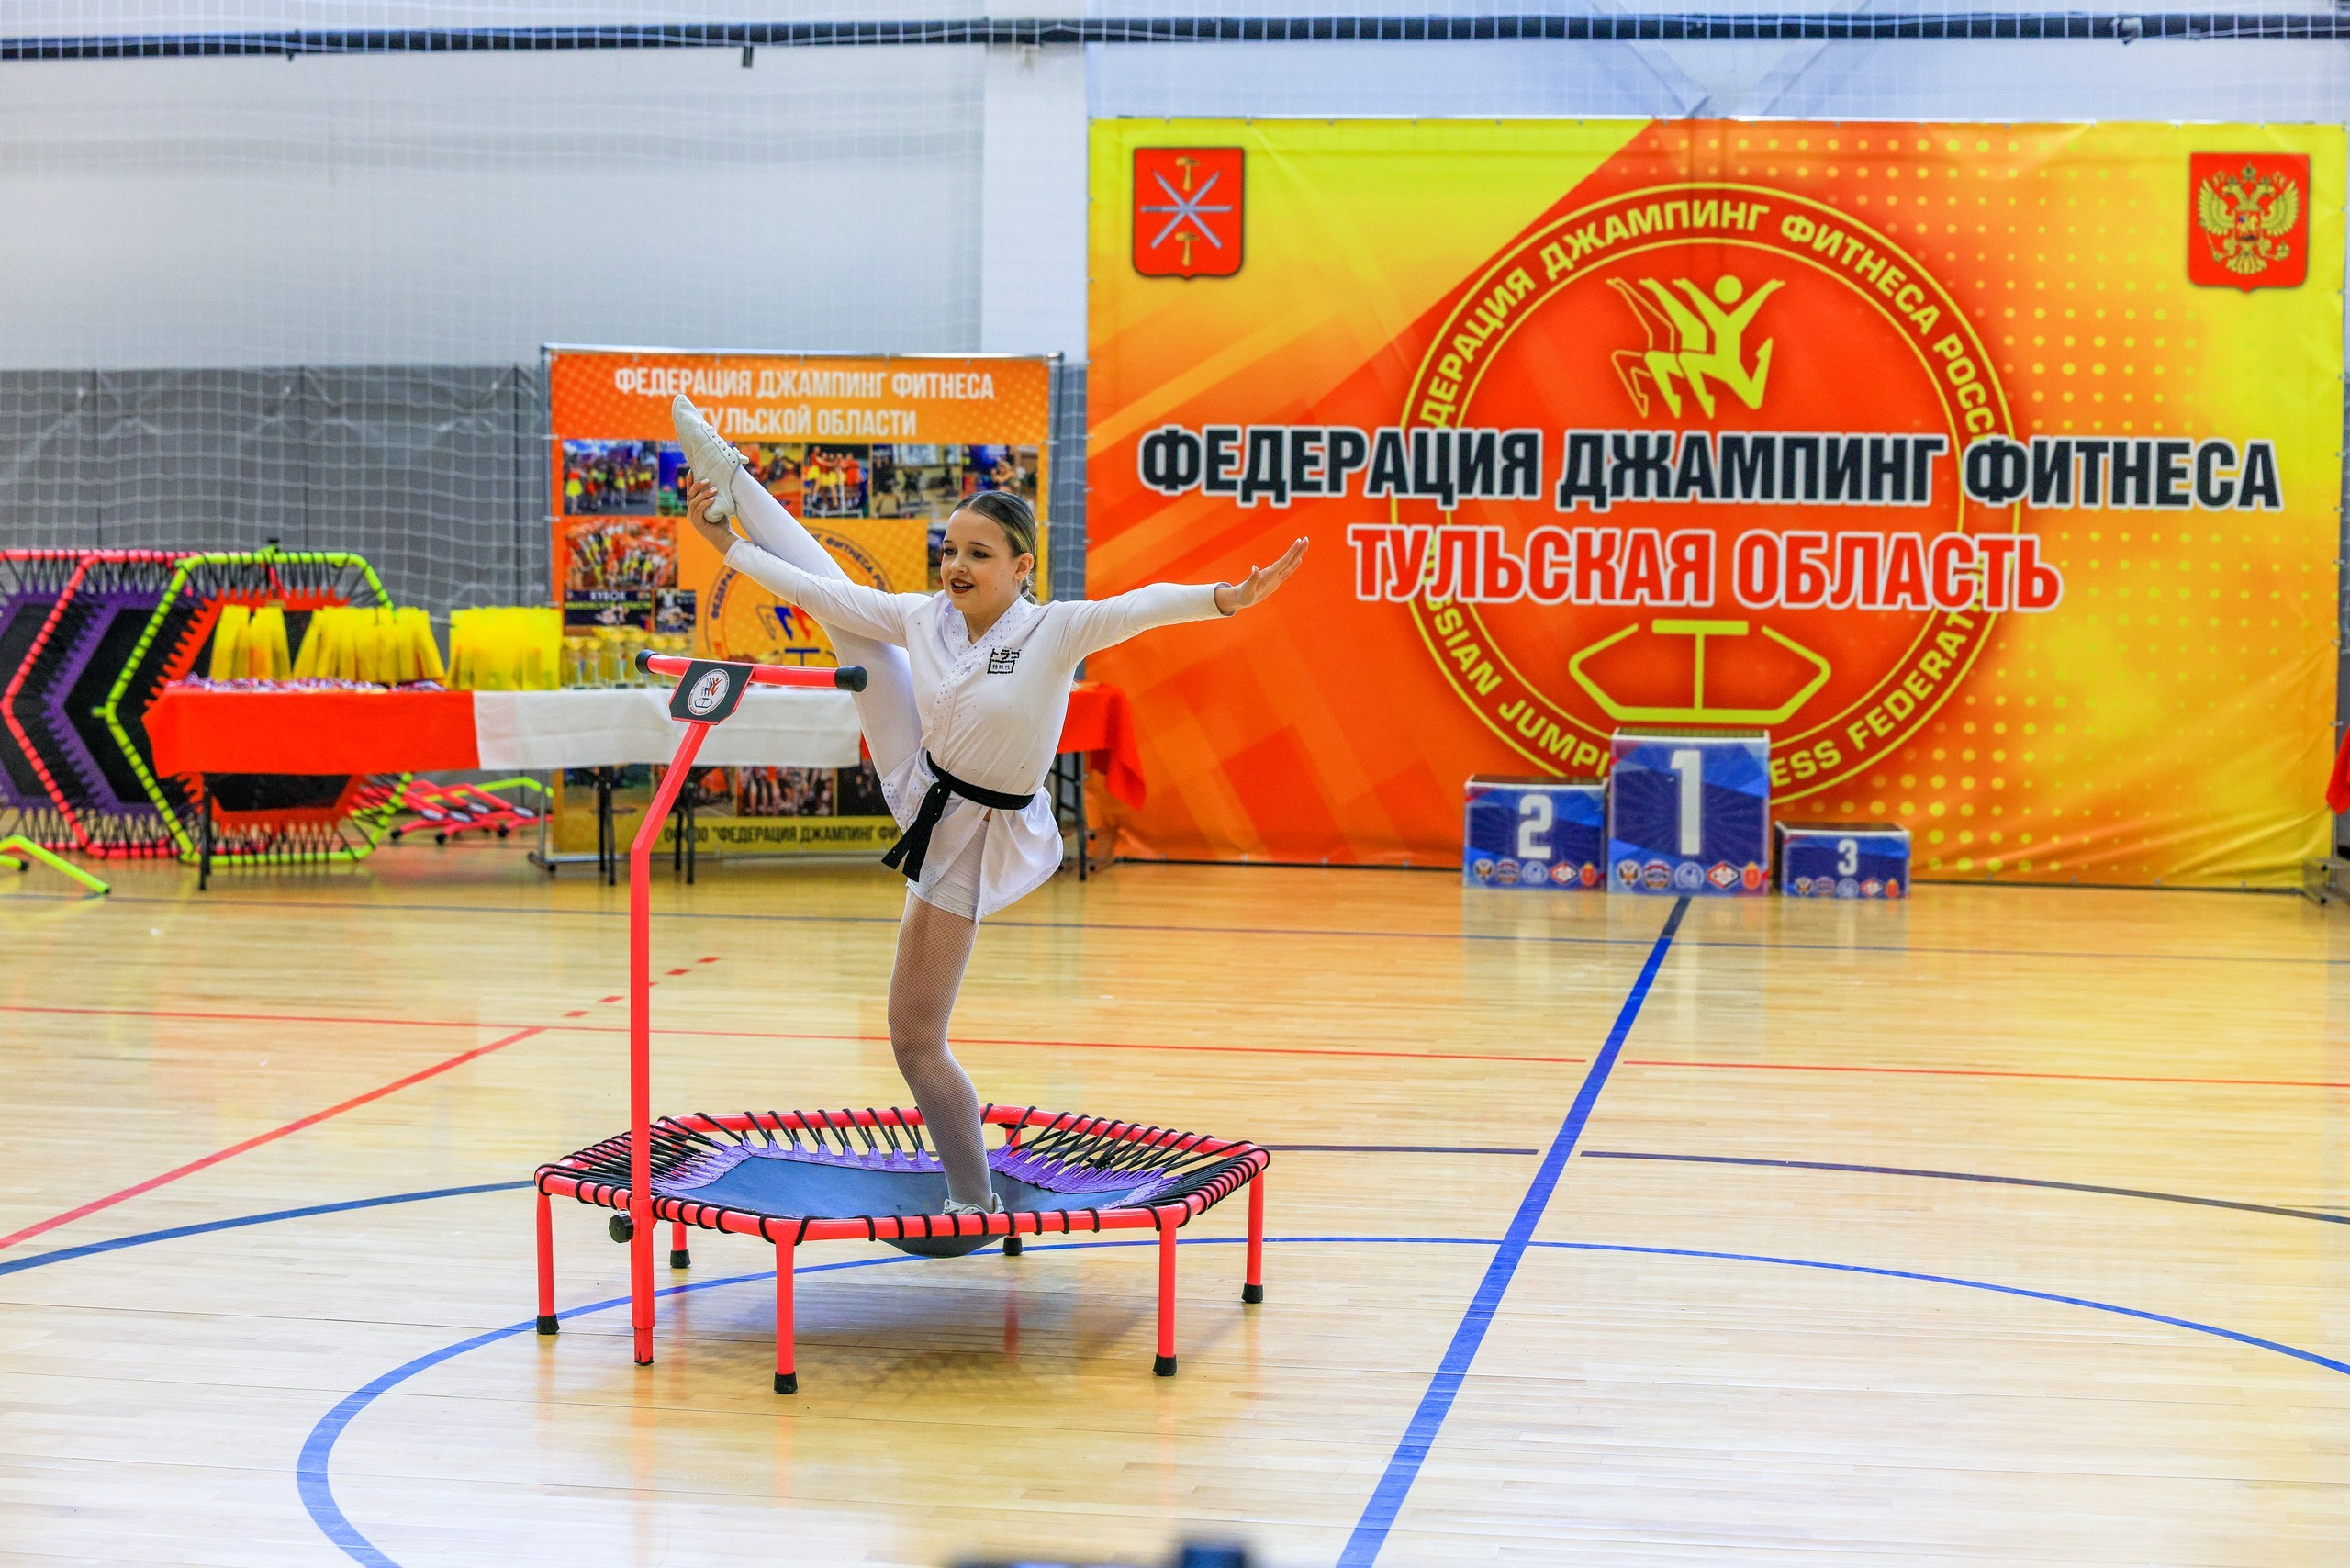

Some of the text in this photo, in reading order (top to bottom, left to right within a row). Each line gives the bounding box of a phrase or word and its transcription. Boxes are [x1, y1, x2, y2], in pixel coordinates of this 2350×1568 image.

[1420, 199, 1998, 441] ДЕРАЦИЯ ДЖАМПИНГ ФИТНЕСА РОСС
[615, 368, 995, 400] ФЕДЕРАЦИЯ ДЖАМПИНГ ФИТНЕСА
[816, 409, 917, 437] ОБЛАСТИ
[1139, 426, 2283, 510] ФЕДЕРАЦИЯ ДЖАМПИНГ ФИТНЕСА
[1349, 523, 2064, 611] ТУЛЬСКАЯ ОБЛАСТЬ
[1847, 595, 1981, 751] FEDERAT
[1498, 699, 1610, 777] JUMPI
[800, 827, 873, 843] ДЖАМПИНГ
[1517, 794, 1553, 859] 2
[1670, 749, 1701, 856] 1
[1837, 839, 1859, 876] 3
